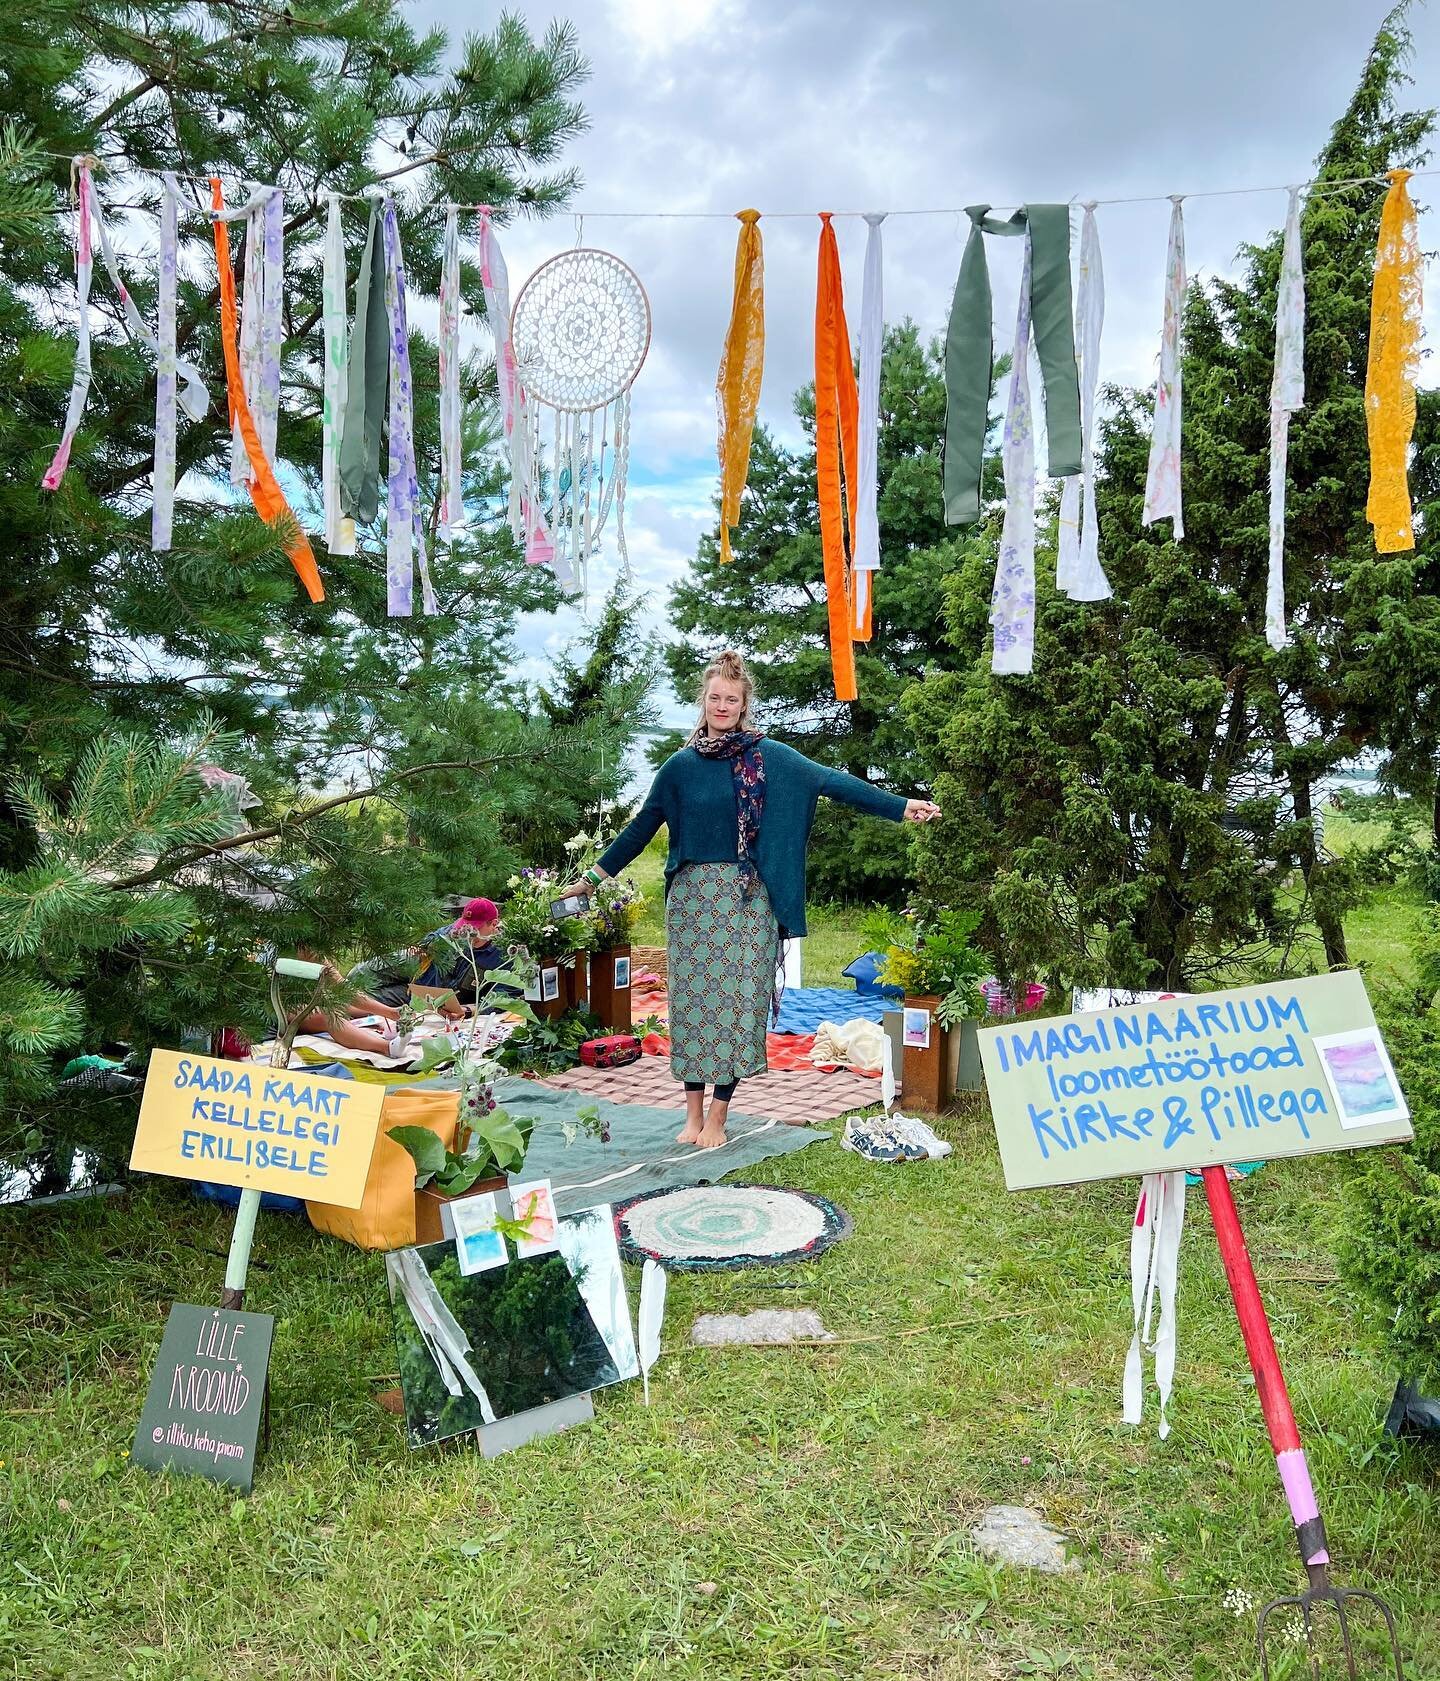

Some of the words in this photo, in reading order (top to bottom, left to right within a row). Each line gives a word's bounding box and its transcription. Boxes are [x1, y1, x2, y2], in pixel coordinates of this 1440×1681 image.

[995, 995, 1309, 1073] IMAGINAARIUM
[174, 1060, 252, 1099] SAADA
[263, 1080, 351, 1117] KAART
[192, 1097, 340, 1147] KELLELEGI
[1162, 1096, 1196, 1149] &
[181, 1130, 329, 1178] ERILISELE
[196, 1311, 246, 1362] LILLE
[168, 1363, 250, 1416] KROONID
